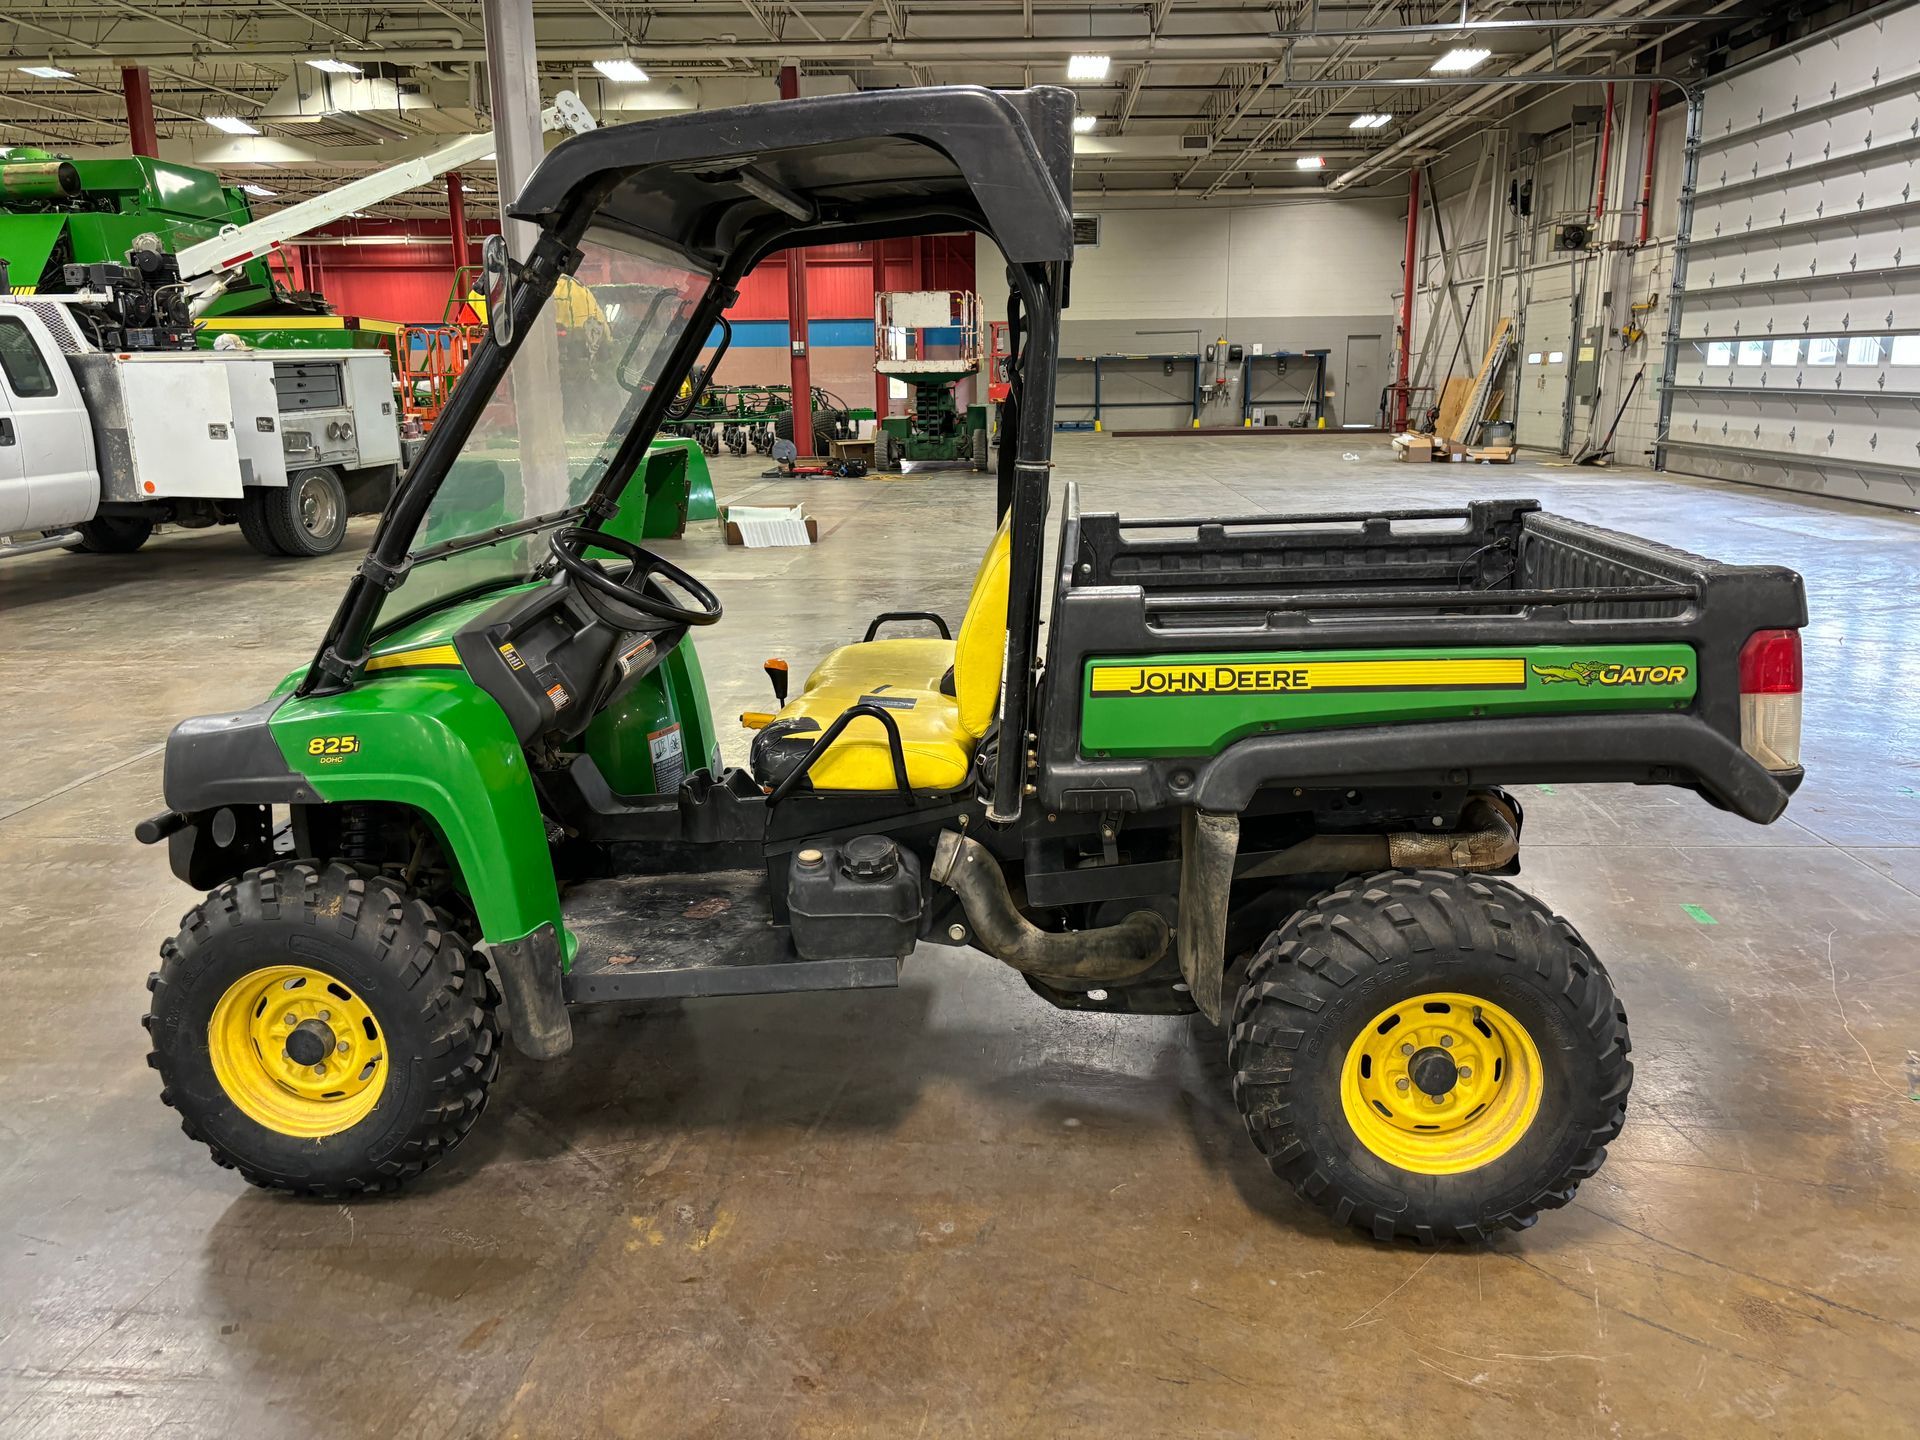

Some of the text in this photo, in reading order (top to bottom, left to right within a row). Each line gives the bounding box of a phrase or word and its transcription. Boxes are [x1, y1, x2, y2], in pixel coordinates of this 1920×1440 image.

[1130, 668, 1309, 690] JOHN DEERE
[1600, 664, 1687, 685] GATOR
[308, 736, 359, 755] 825i
[320, 756, 343, 764] DOHC
